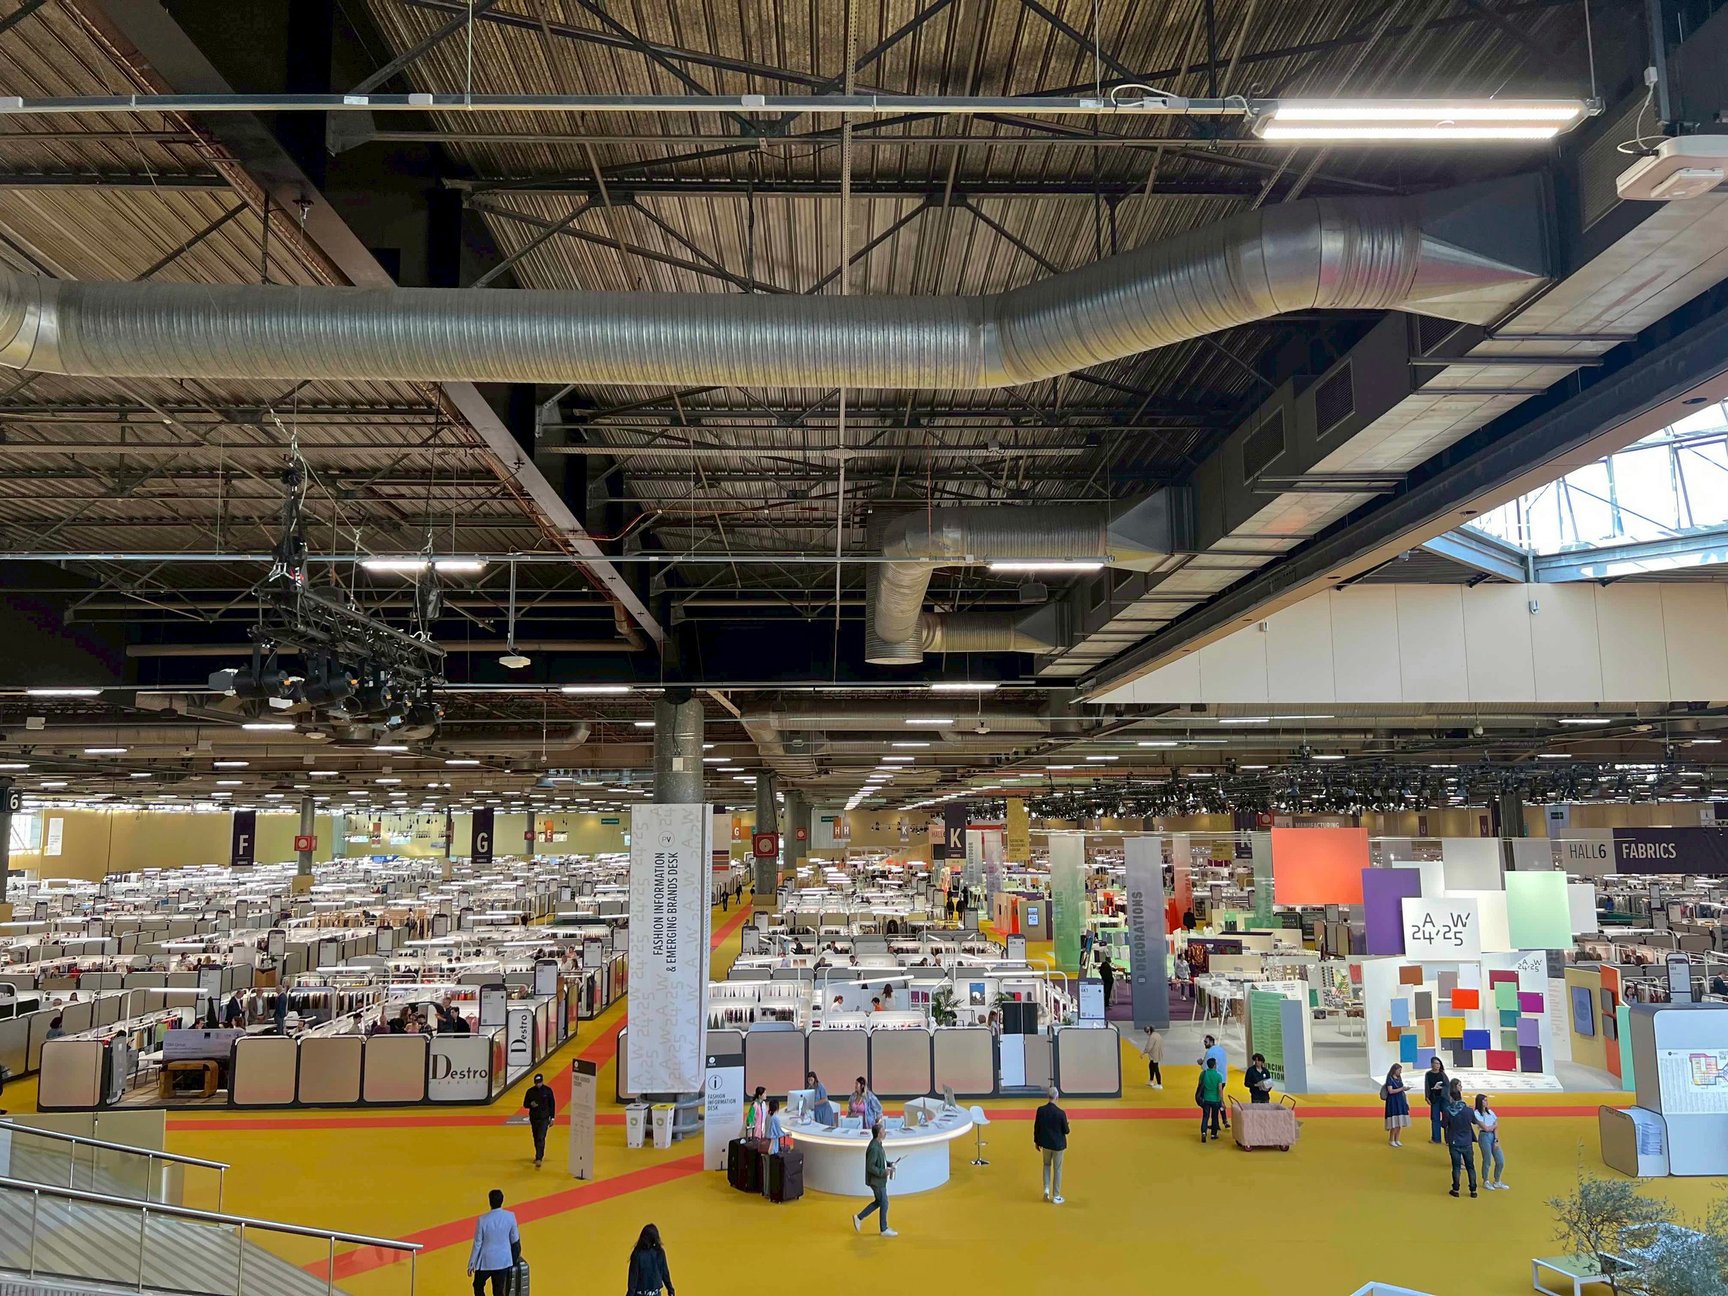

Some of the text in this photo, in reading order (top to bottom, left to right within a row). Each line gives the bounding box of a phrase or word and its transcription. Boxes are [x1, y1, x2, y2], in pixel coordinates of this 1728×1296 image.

[10, 794, 19, 810] 6
[547, 829, 552, 839] E
[734, 827, 740, 836] G
[834, 826, 840, 835] H
[844, 826, 850, 835] H
[902, 826, 907, 835] K
[950, 827, 962, 848] K
[1240, 828, 1251, 848] K
[1482, 825, 1487, 834] V
[239, 834, 249, 855] F
[476, 832, 489, 853] G
[1622, 842, 1677, 859] FABRICS
[667, 852, 679, 875] DESK
[653, 852, 665, 956] FASHION INFORMATION
[667, 877, 678, 914] BRANDS
[1422, 912, 1436, 928] A
[666, 916, 677, 964] EMERGING
[1131, 891, 1147, 971] DECORATIONS
[510, 1014, 528, 1054] Destro
[430, 1053, 488, 1080] Destro
